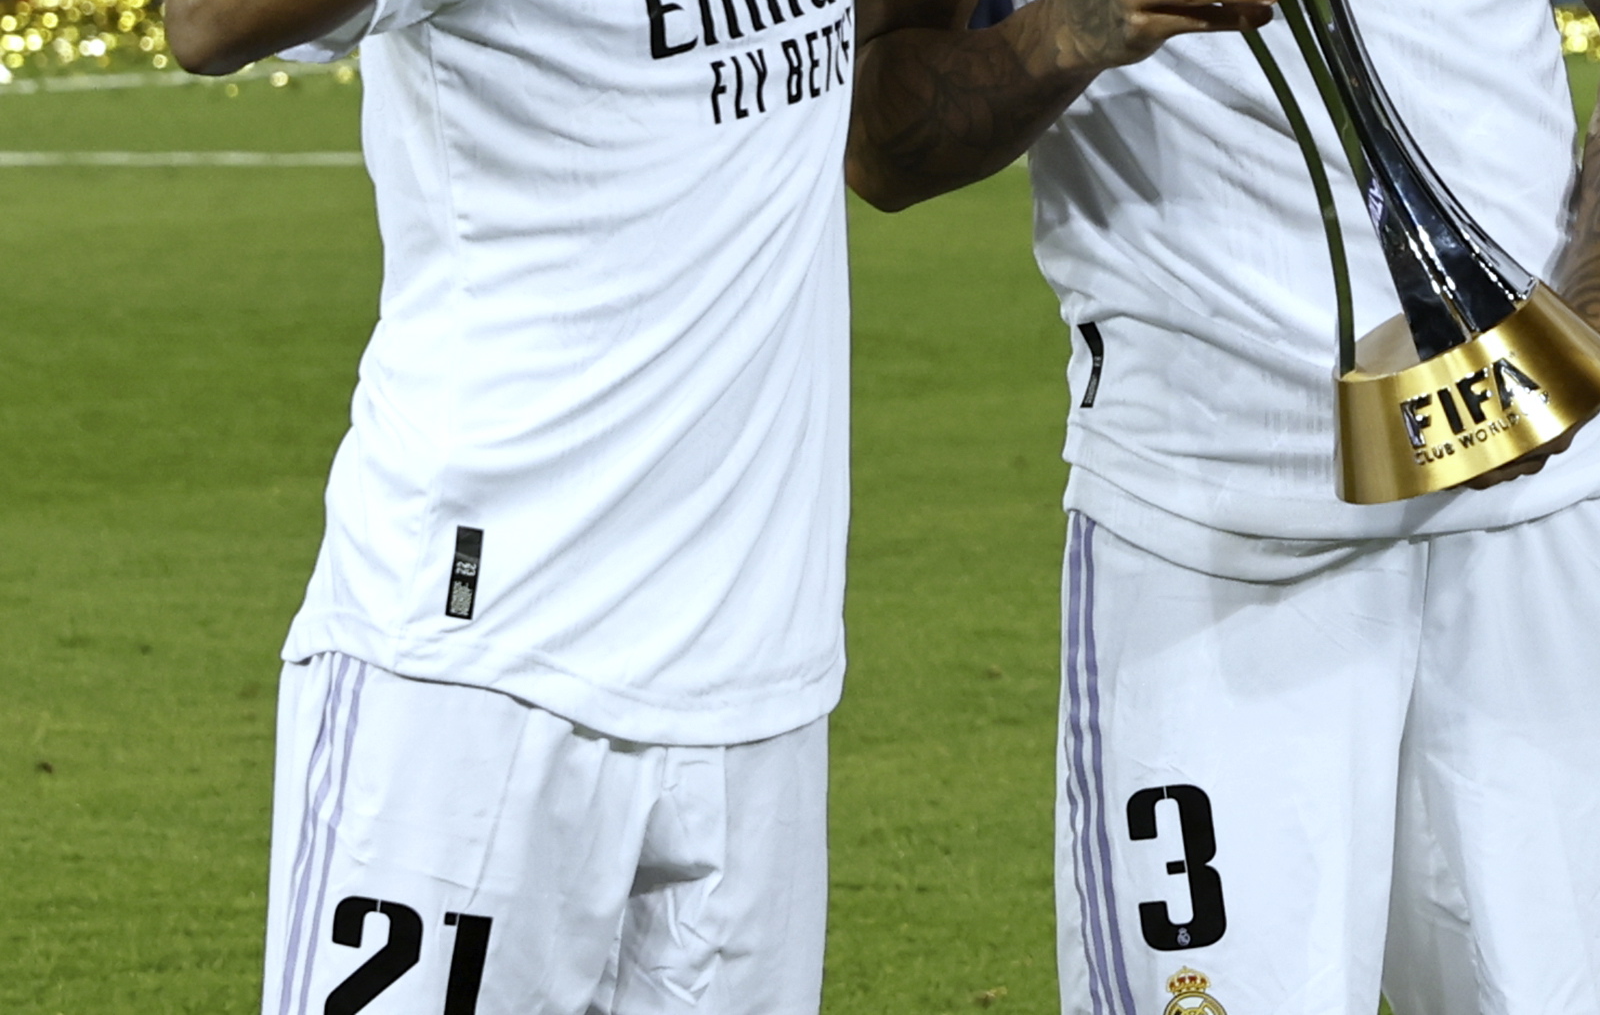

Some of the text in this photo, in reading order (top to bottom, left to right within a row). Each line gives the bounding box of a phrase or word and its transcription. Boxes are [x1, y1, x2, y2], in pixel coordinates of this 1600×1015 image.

[710, 47, 769, 125] FLY
[1400, 357, 1549, 449] FIFA
[1414, 442, 1456, 466] CLUB
[1127, 784, 1227, 952] 3
[324, 896, 494, 1015] 21
